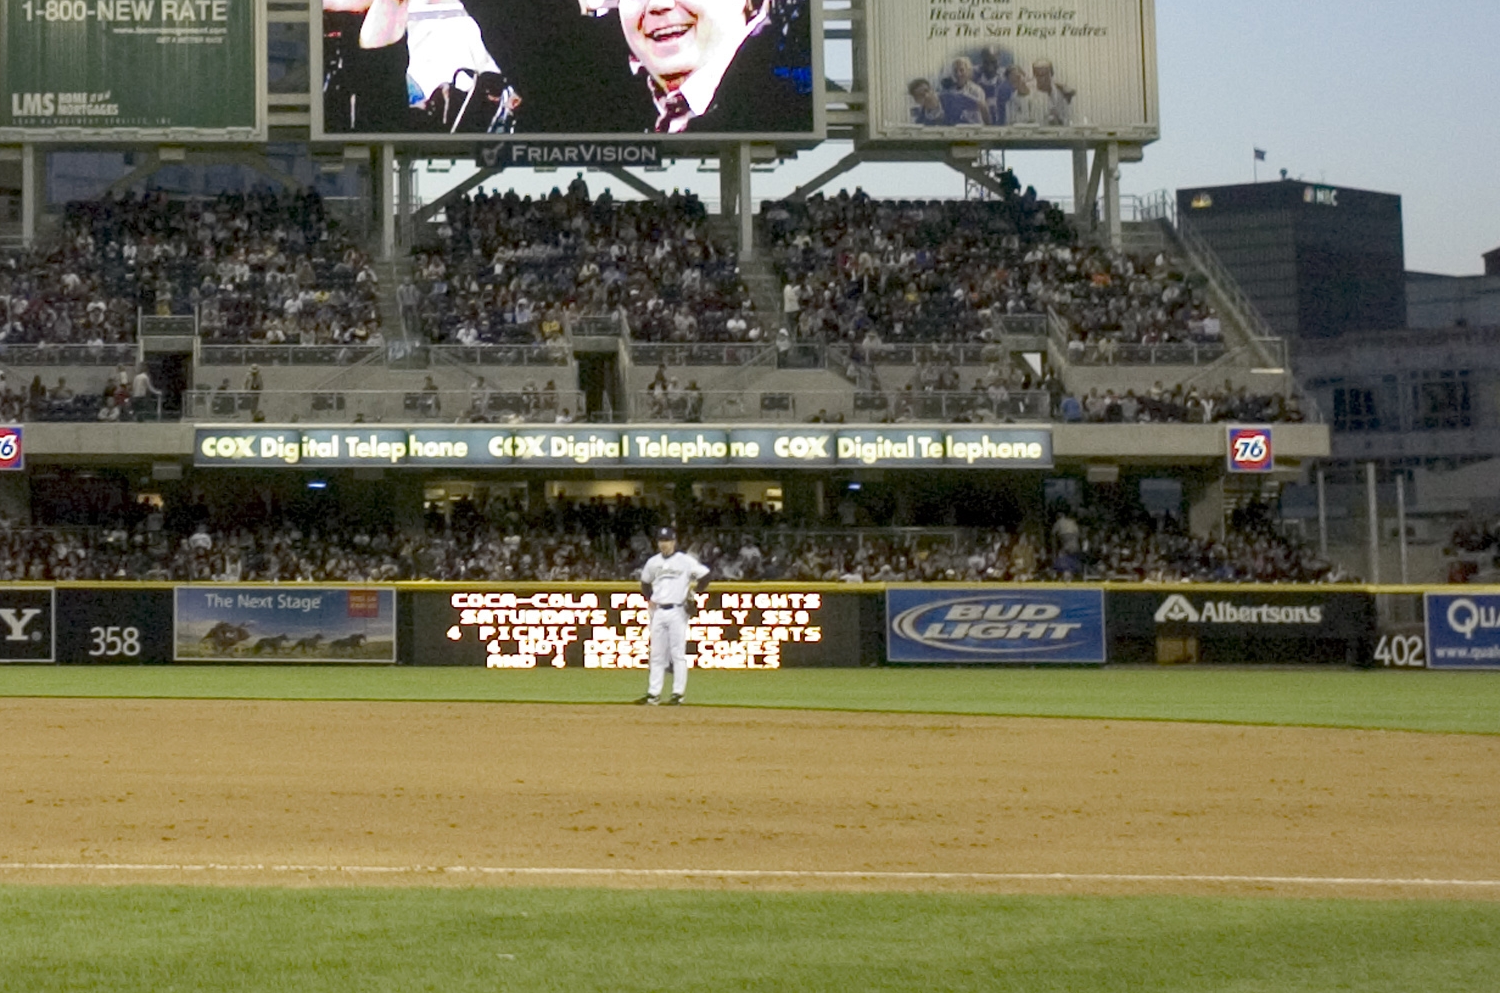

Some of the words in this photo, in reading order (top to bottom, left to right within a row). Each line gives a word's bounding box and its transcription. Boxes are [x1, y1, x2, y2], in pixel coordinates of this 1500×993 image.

[22, 0, 155, 21] 1-800-NEW
[161, 0, 228, 21] RATE
[930, 7, 975, 20] Health
[980, 8, 1012, 20] Care
[1017, 7, 1076, 20] Provider
[927, 24, 950, 40] for
[956, 24, 980, 37] The
[985, 24, 1011, 37] San
[1015, 24, 1056, 39] Diego
[1060, 24, 1108, 37] Padres
[12, 92, 55, 116] LMS
[58, 92, 88, 104] HOME
[201, 435, 257, 458] COX
[260, 435, 339, 463] Digital
[345, 435, 468, 463] Telephone
[488, 435, 547, 458] COX
[550, 435, 629, 463] Digital
[636, 435, 759, 463] Telephone
[774, 435, 830, 458] COX
[837, 435, 914, 463] Digital
[918, 435, 1042, 463] Telephone
[1234, 435, 1267, 461] 76
[205, 593, 233, 609] The
[238, 594, 273, 609] Next
[278, 594, 321, 612] Stage
[451, 593, 598, 609] COCA-COLA
[460, 609, 607, 624] SATURDAYS
[944, 604, 1061, 621] BUD
[1200, 601, 1323, 623] Albertsons
[447, 626, 462, 640] 4
[479, 626, 577, 640] PICNIC
[739, 626, 821, 642] SEATS
[923, 622, 1082, 640] LIGHT
[88, 626, 141, 657] 358
[487, 640, 501, 654] 4
[518, 640, 568, 655] HOT
[698, 641, 780, 655] COKES
[1373, 635, 1423, 666] 402
[487, 655, 536, 668] AND
[551, 655, 566, 668] 4
[686, 655, 780, 668] TOWELS
